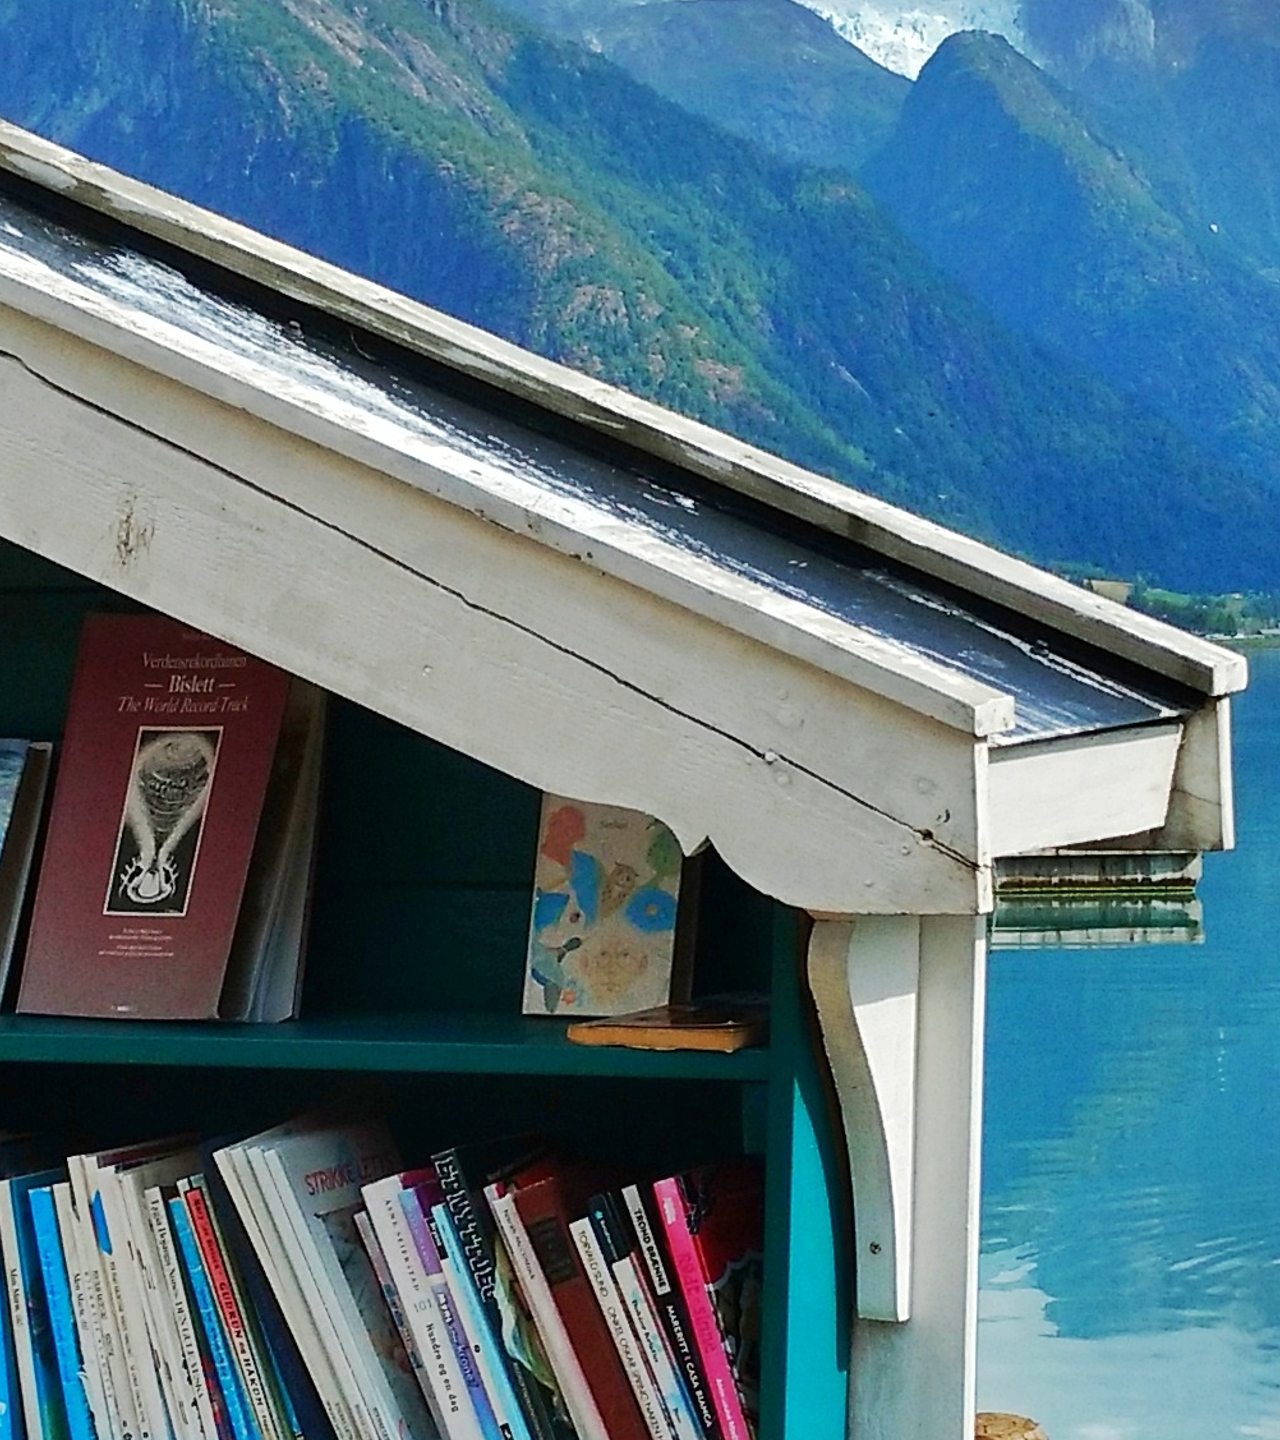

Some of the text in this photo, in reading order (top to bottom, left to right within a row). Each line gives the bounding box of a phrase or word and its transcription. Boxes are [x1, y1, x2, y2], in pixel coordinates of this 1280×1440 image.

[118, 696, 140, 712] The
[144, 696, 178, 713] World
[168, 674, 215, 693] Bislett
[630, 1207, 653, 1245] TROND
[643, 1245, 667, 1288] BRÆNNE
[217, 1281, 243, 1339] GUDRUN
[241, 1355, 266, 1407] HÅKON
[424, 1322, 462, 1413] Hundre og en dag
[664, 1303, 715, 1429] MARERITT CASA BIANCA
